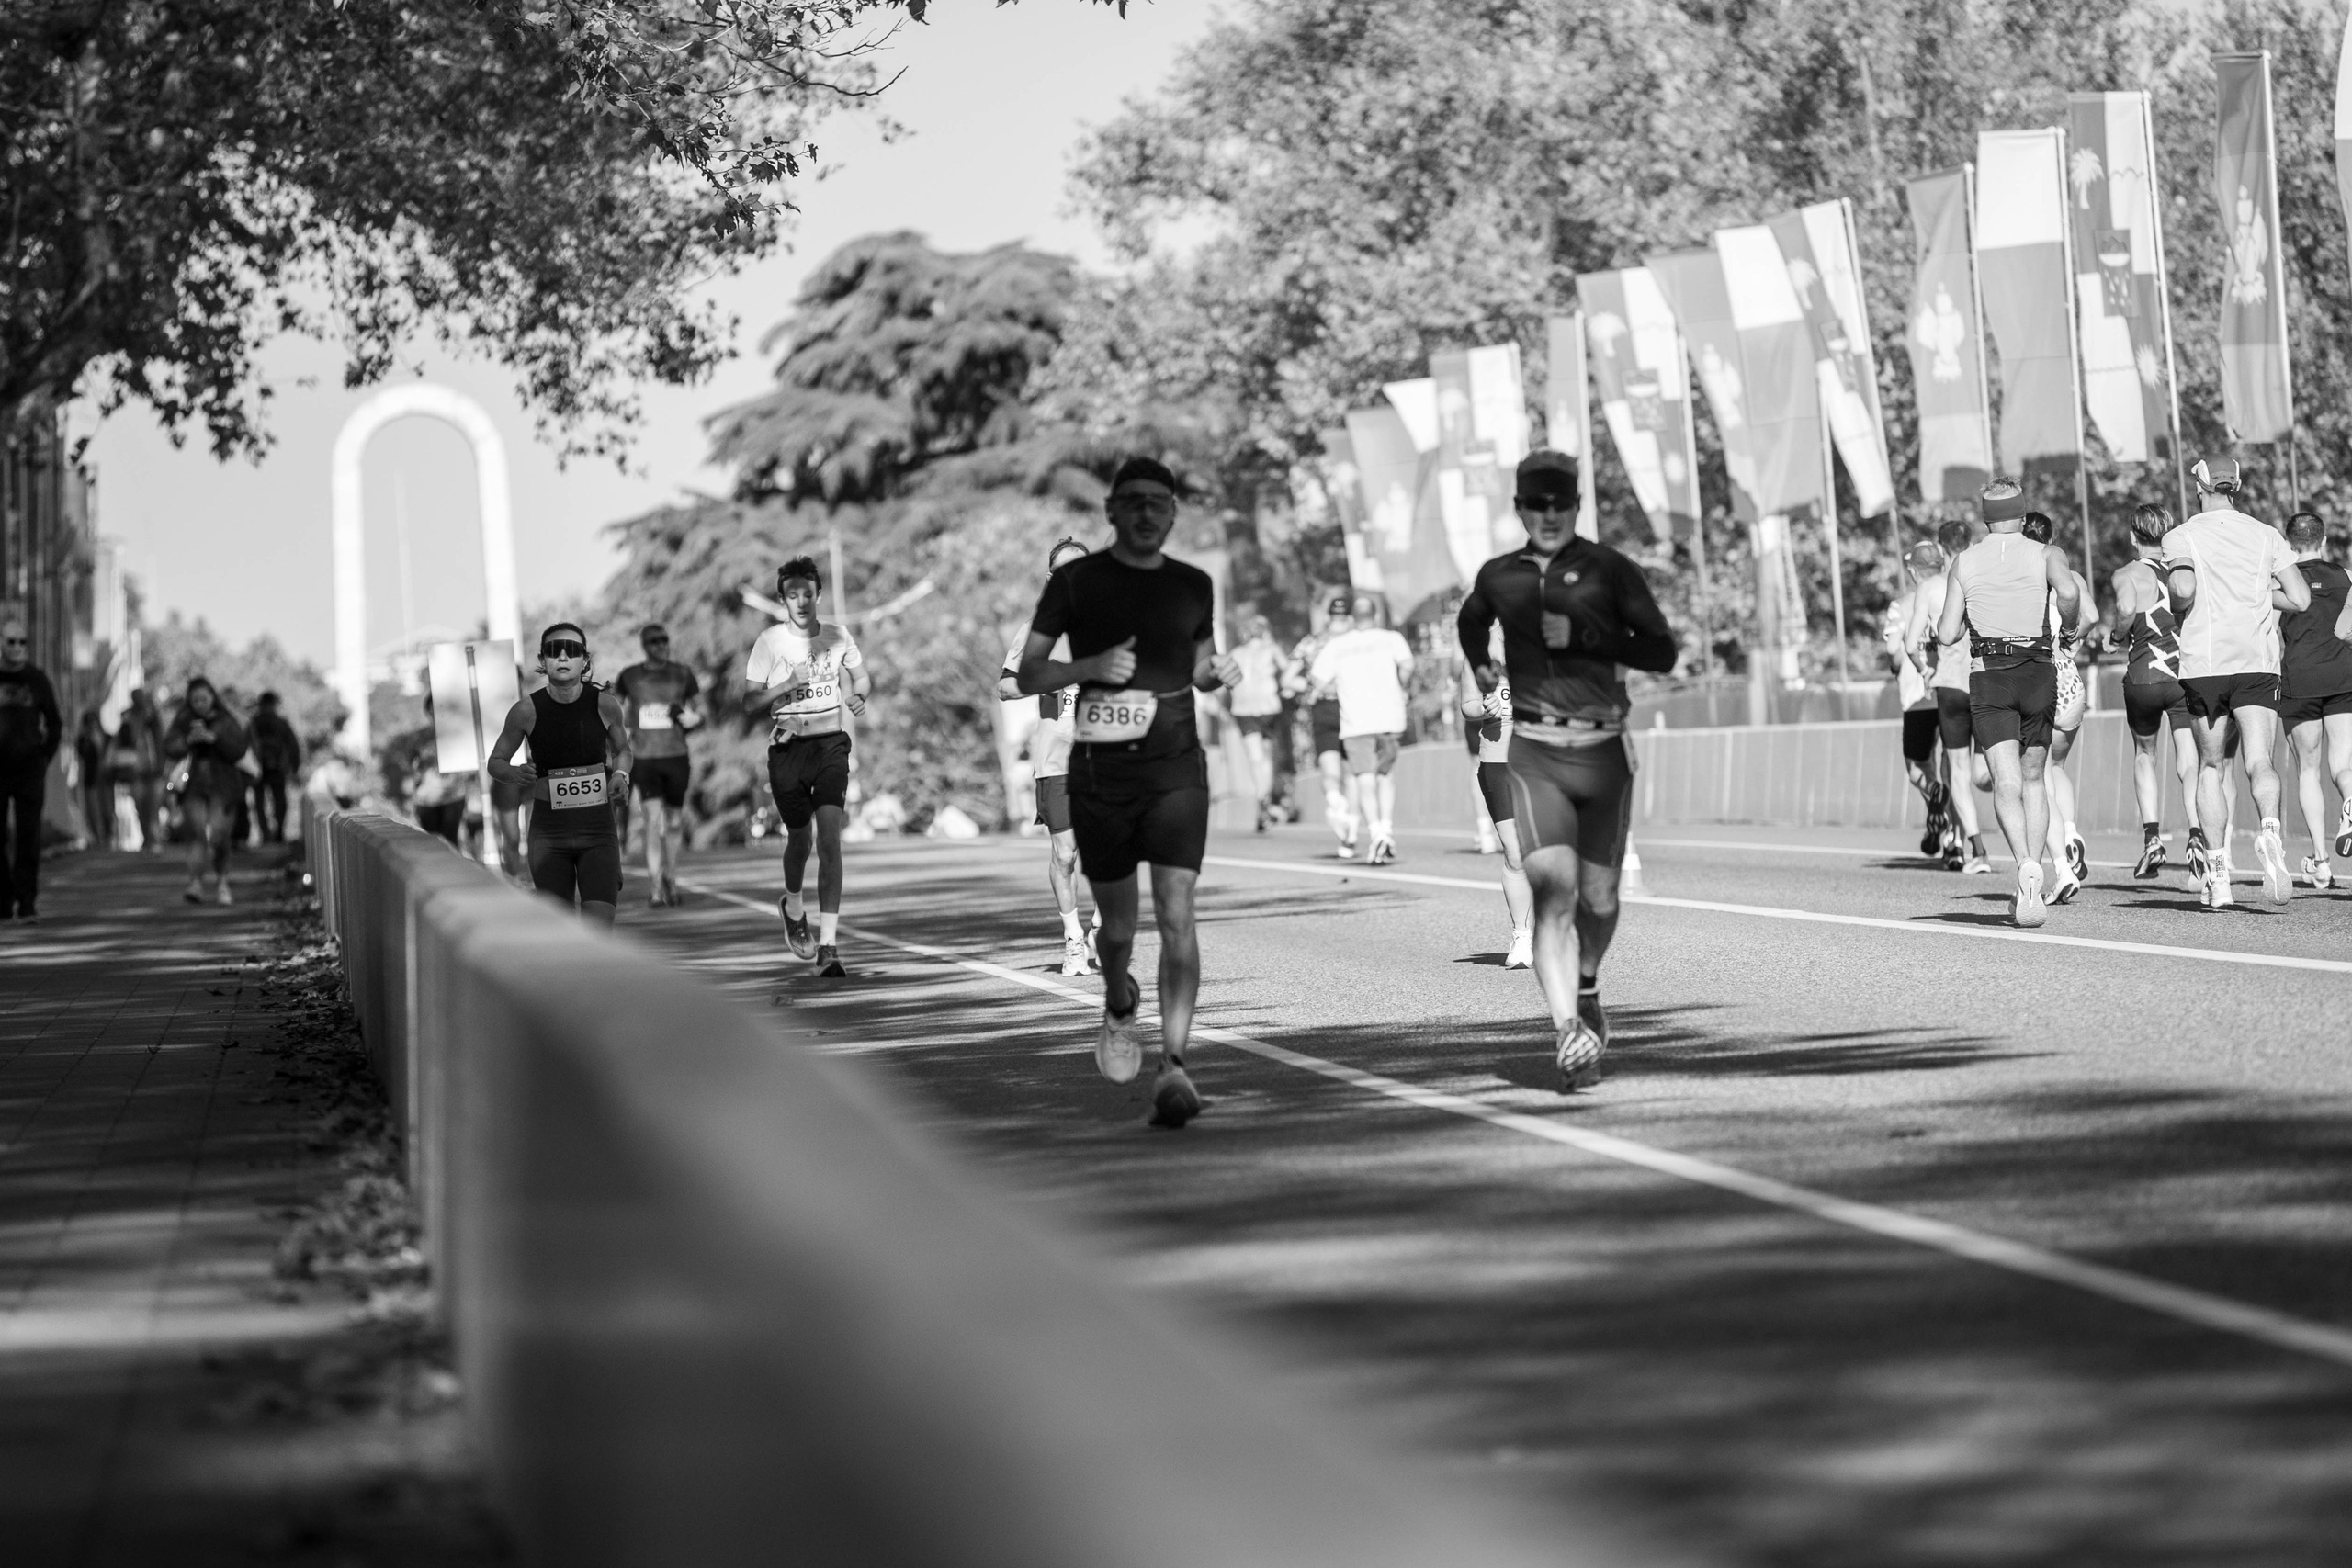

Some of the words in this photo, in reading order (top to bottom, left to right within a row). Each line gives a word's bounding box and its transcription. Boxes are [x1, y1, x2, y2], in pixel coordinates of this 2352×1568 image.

[796, 685, 831, 700] 5060
[1086, 705, 1146, 725] 6386
[556, 778, 602, 796] 6653
